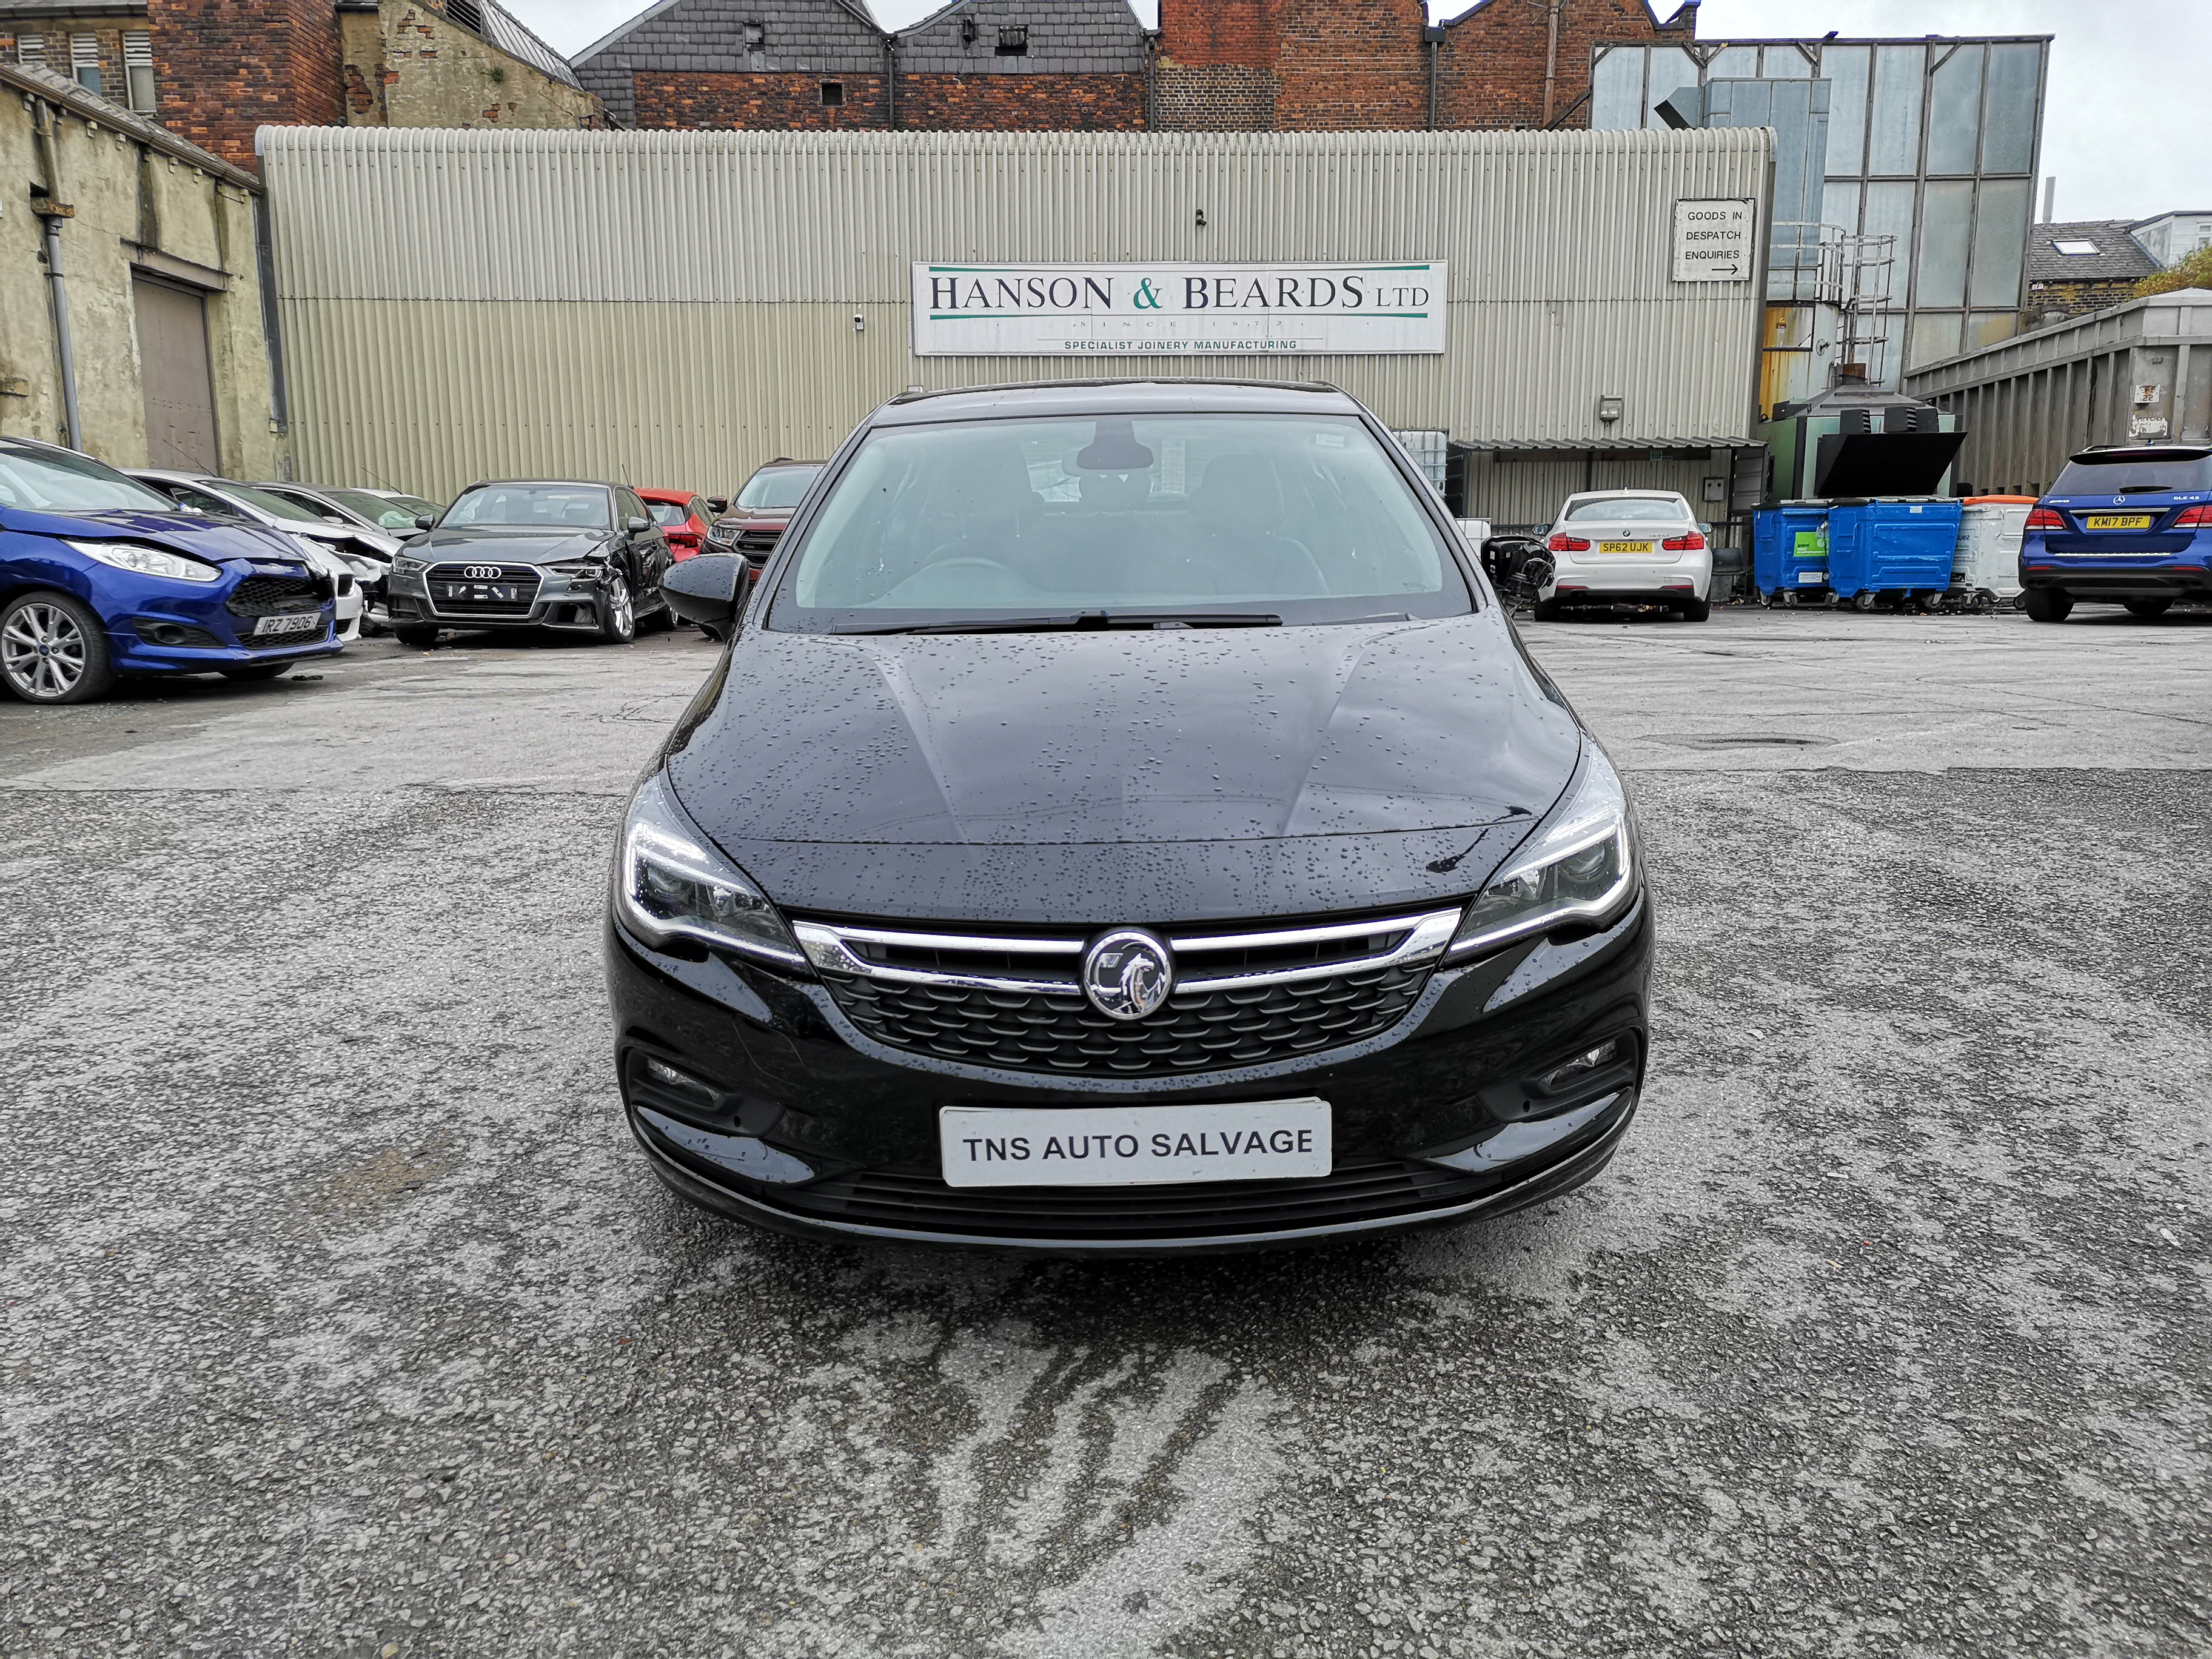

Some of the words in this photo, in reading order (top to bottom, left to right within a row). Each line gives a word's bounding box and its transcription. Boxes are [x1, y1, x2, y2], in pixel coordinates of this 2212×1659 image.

[1687, 211, 1726, 221] GOODS
[1732, 211, 1743, 220] IN
[1686, 230, 1741, 240] DESPATCH
[1685, 250, 1740, 260] ENQUIRIES
[929, 277, 1114, 309] HANSON
[1133, 277, 1163, 309] &
[1182, 276, 1364, 309] BEARDS
[1375, 287, 1429, 307] LTD
[1065, 341, 1133, 350] SPECIALIST
[1138, 341, 1188, 350] JOINERY
[1193, 340, 1297, 350] MANUFACTURING
[2094, 517, 2119, 527] KM17
[2120, 517, 2143, 526] BPF
[1603, 543, 1628, 552] SP62
[1630, 543, 1649, 552] UJK
[261, 618, 283, 633] IRZ
[284, 615, 313, 631] 7906
[962, 1137, 1031, 1162] TNS
[1042, 1134, 1139, 1161] AUTO
[1151, 1129, 1313, 1158] SALVAGE
